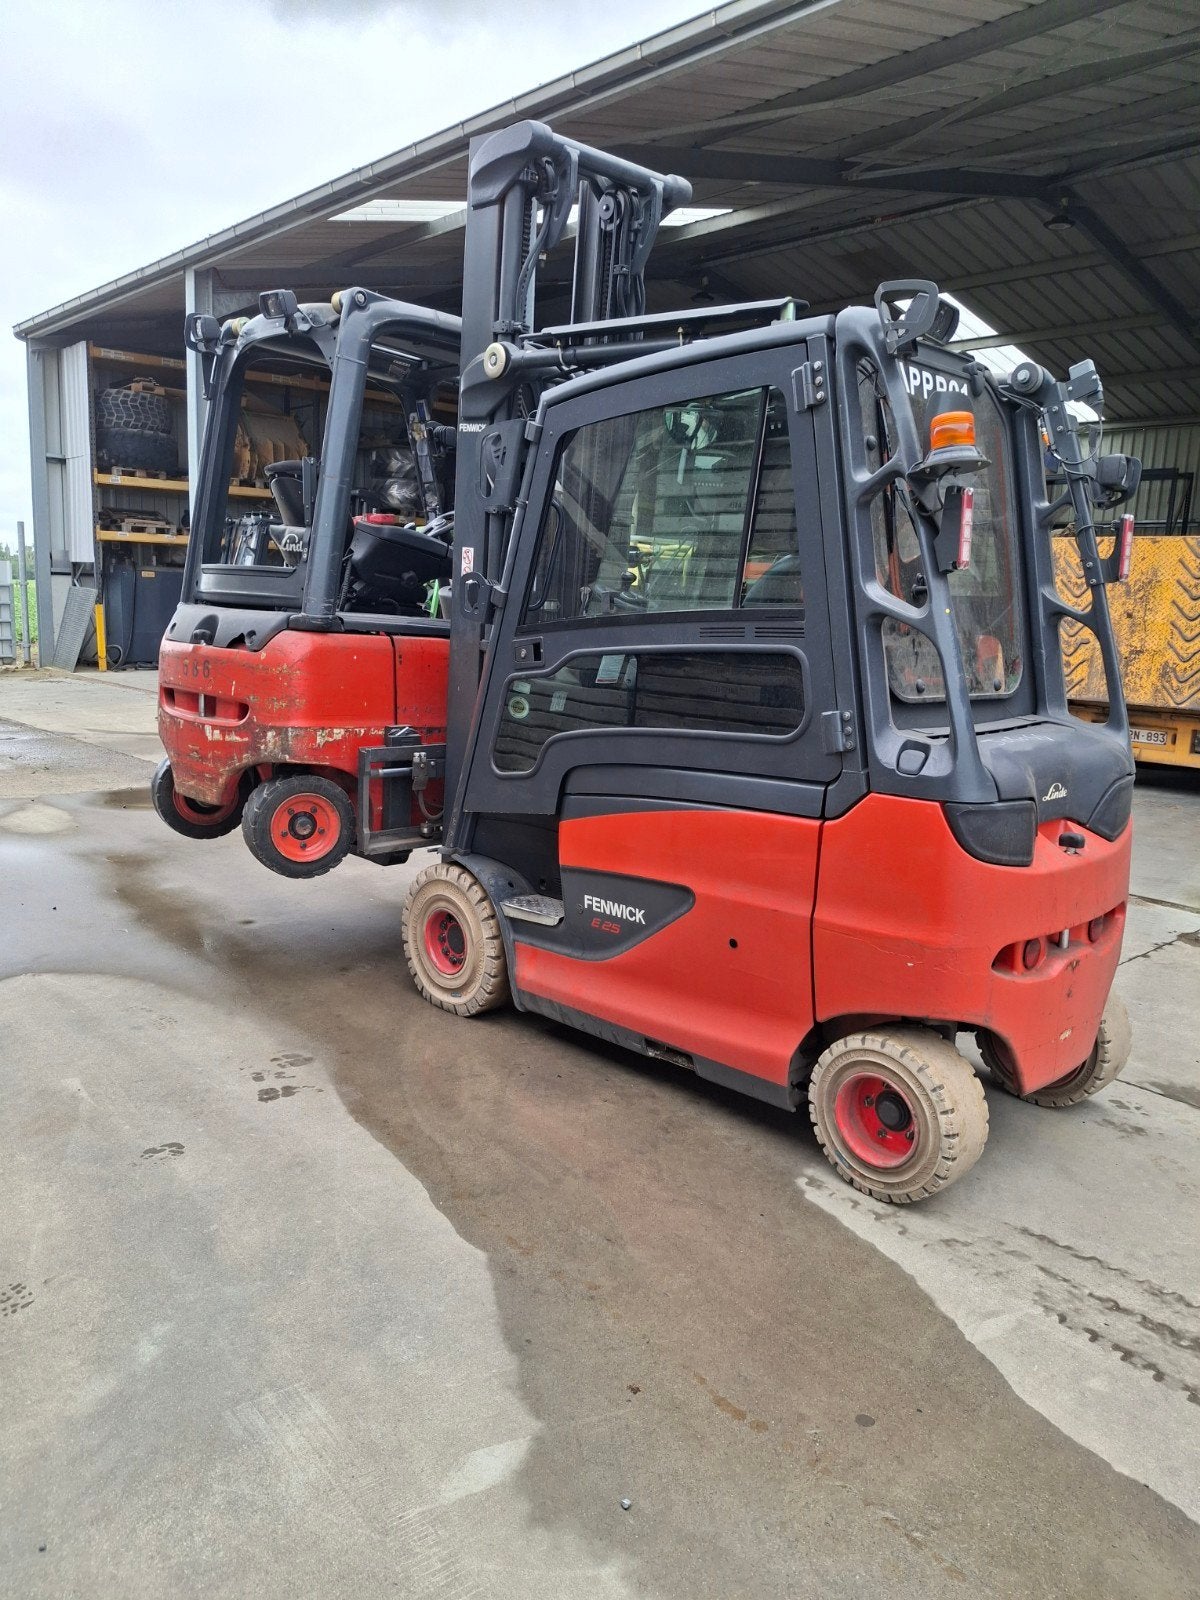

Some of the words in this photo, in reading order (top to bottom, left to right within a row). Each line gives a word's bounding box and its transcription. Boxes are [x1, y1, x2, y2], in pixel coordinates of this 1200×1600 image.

[1042, 782, 1068, 802] Linde
[584, 894, 646, 925] FENWICK
[591, 917, 602, 928] E
[601, 920, 621, 934] 25
